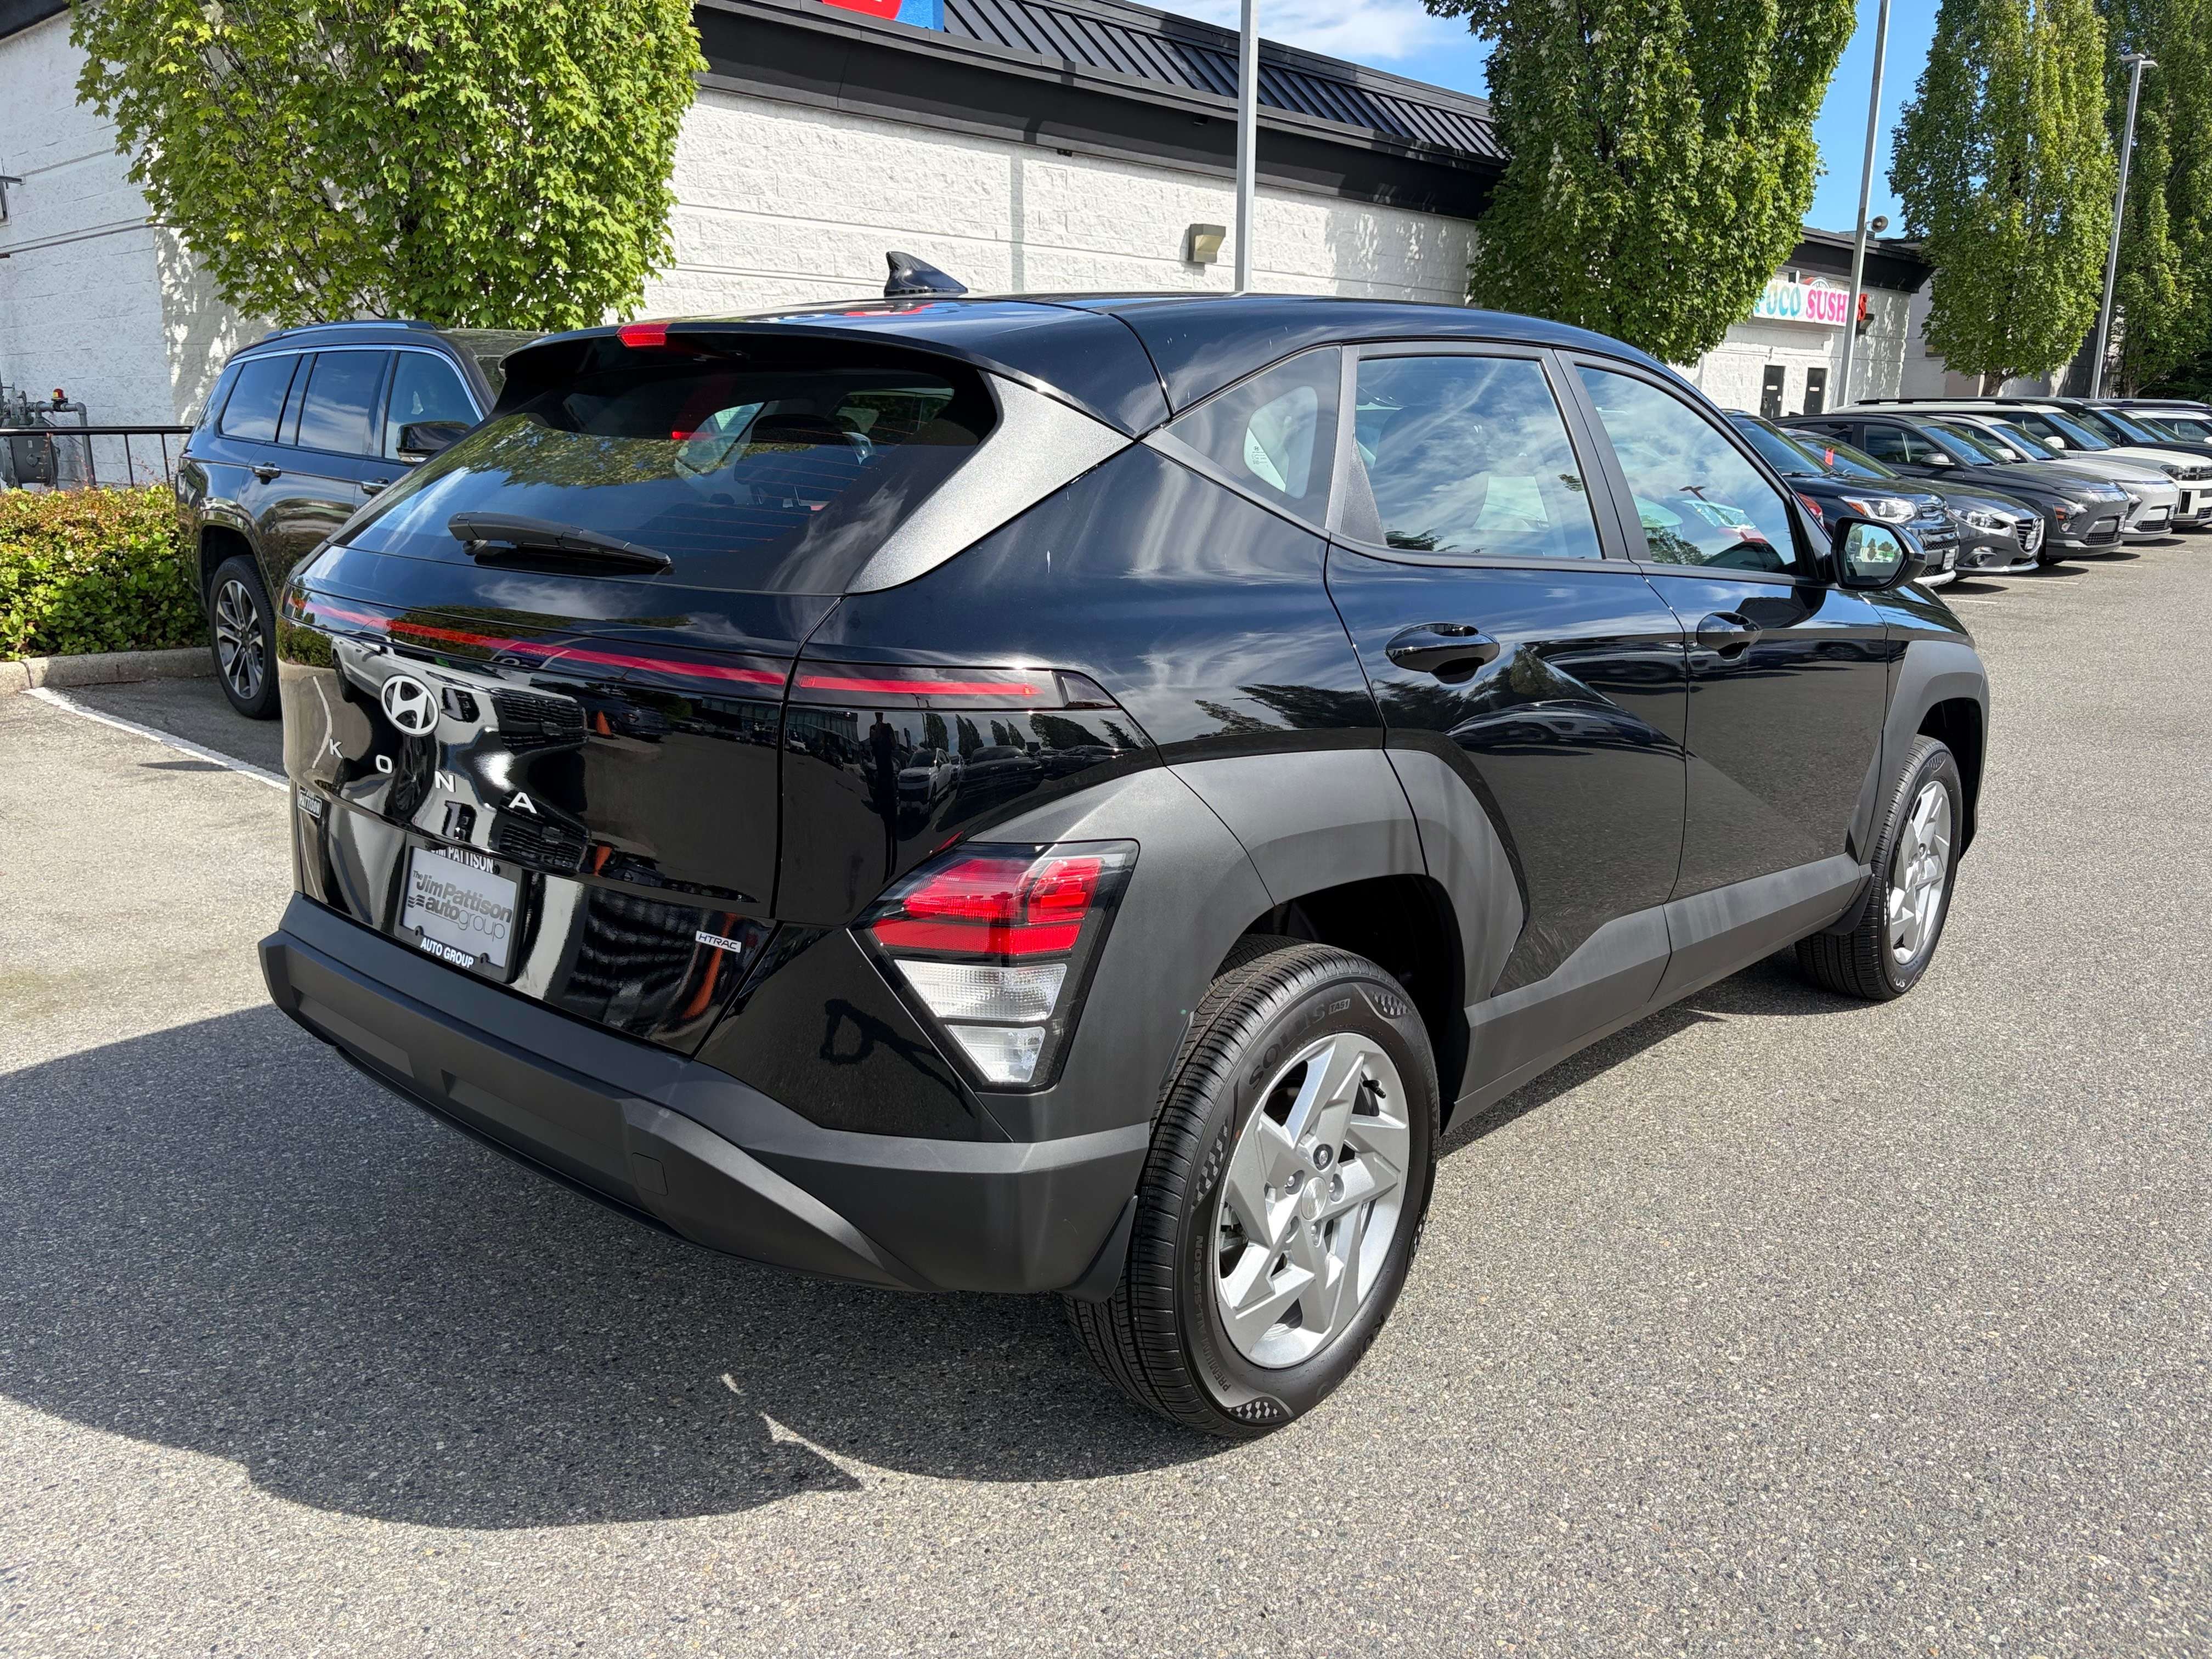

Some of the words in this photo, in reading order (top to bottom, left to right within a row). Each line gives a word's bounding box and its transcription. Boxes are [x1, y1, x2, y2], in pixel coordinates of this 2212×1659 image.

[329, 738, 537, 814] KONA
[299, 793, 321, 815] PATTISON
[448, 846, 494, 874] PATTISON
[413, 870, 424, 881] The
[420, 936, 443, 956] AUTO
[443, 946, 475, 969] GROUP
[698, 933, 738, 950] HTRAC
[1329, 1000, 1350, 1013] TA51
